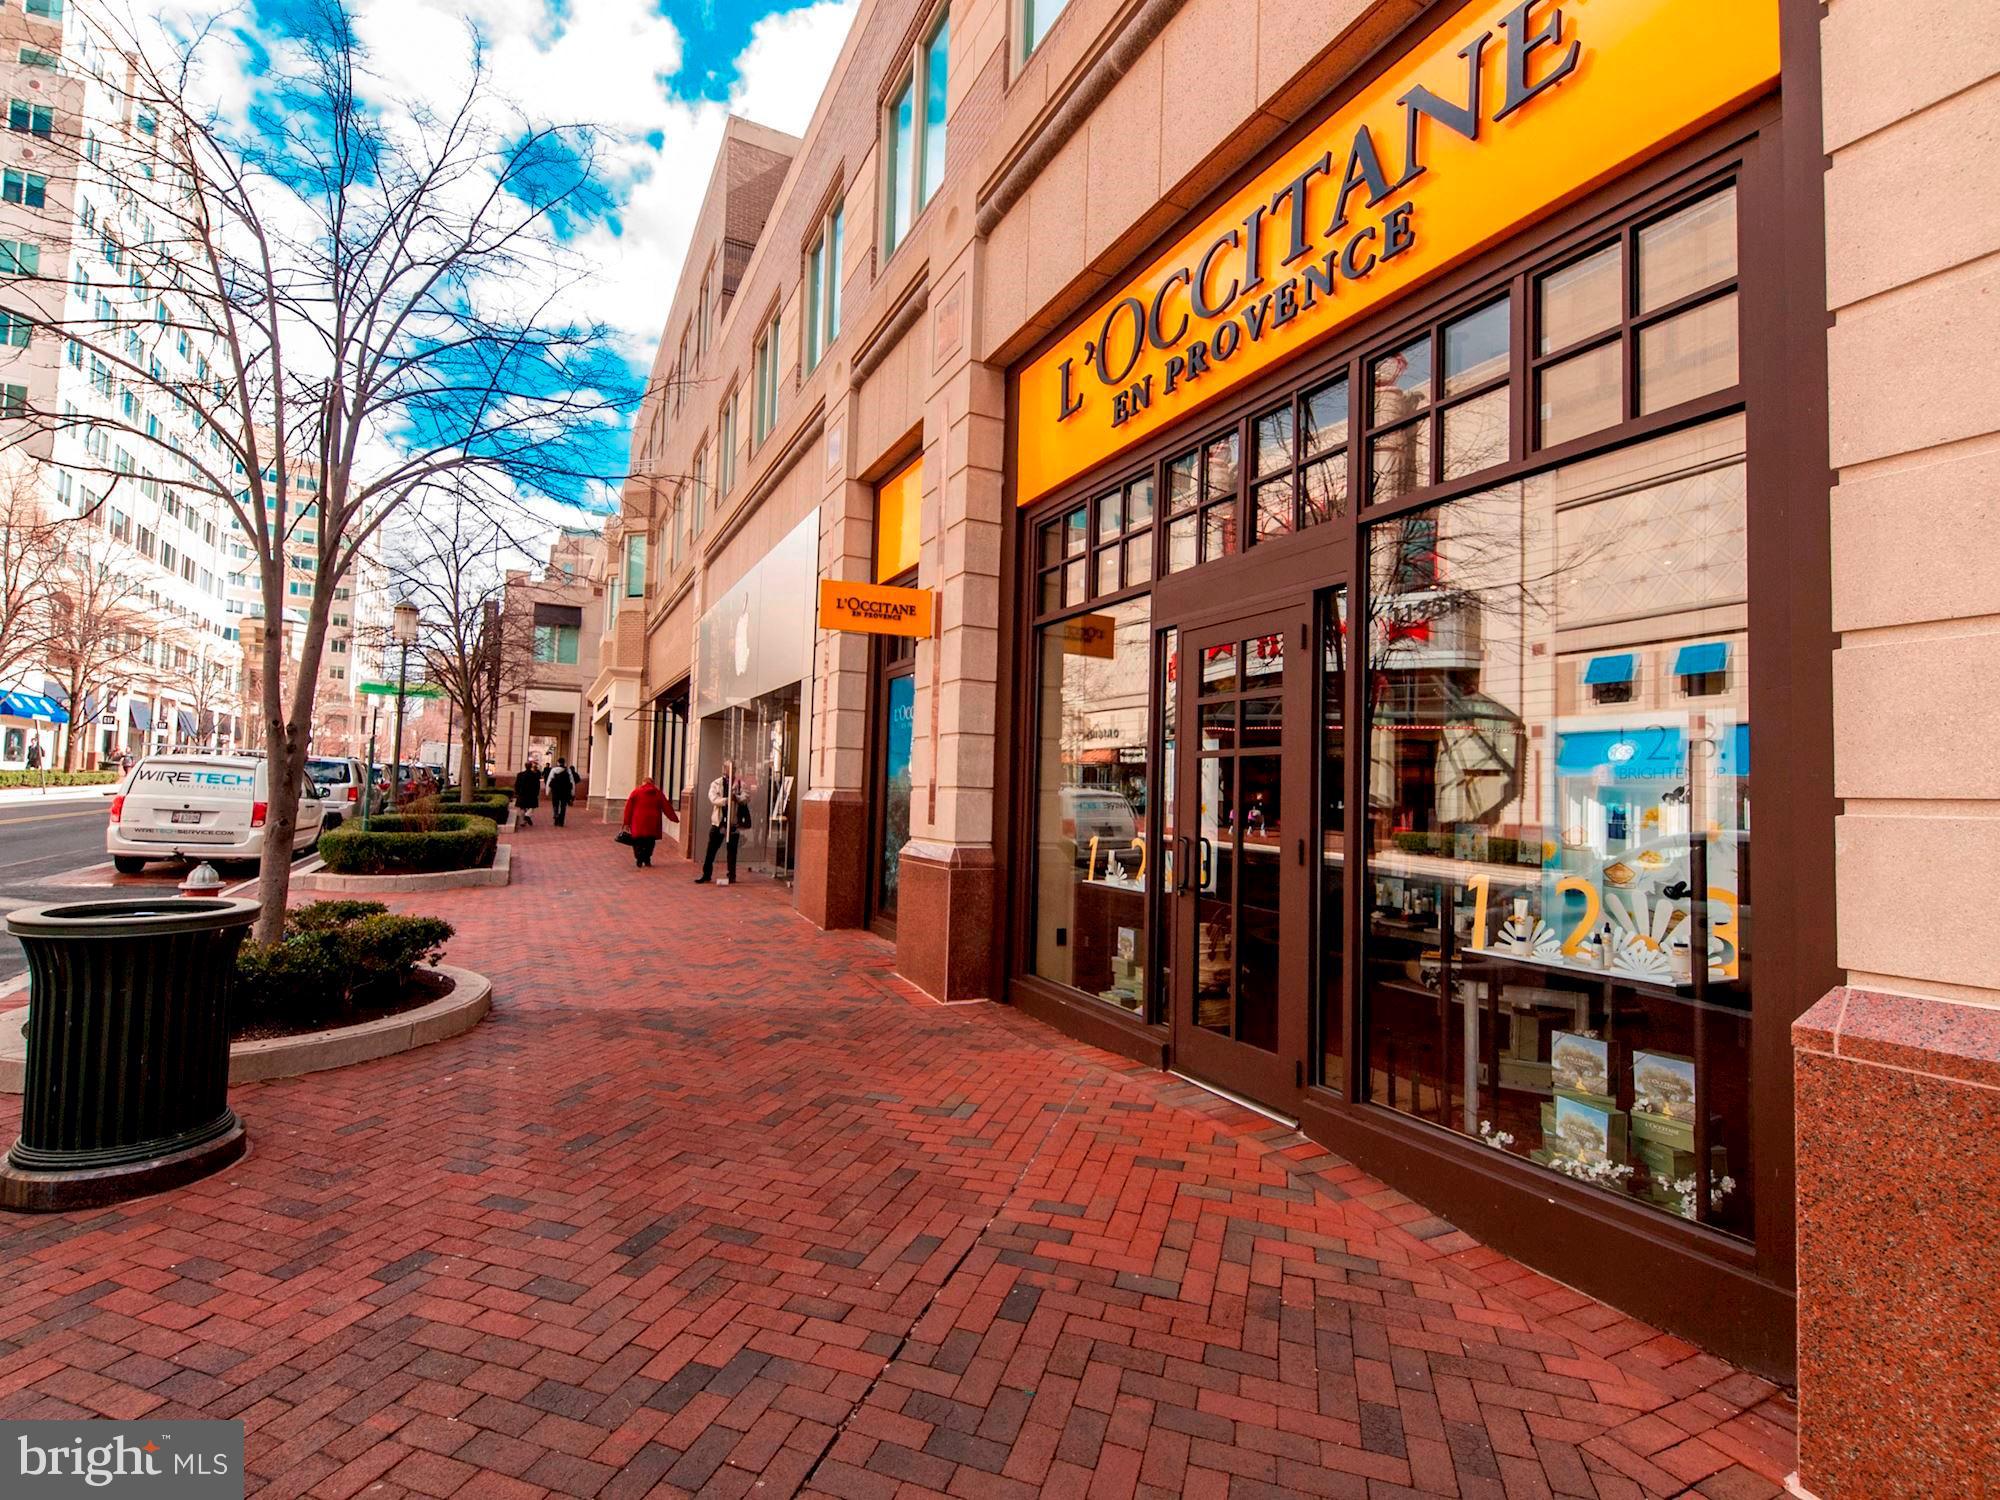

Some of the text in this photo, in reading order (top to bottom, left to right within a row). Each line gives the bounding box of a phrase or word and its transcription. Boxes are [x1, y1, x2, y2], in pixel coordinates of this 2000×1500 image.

[1057, 0, 1581, 422] L'OCCITANE
[1112, 201, 1416, 428] EN PROVENCE
[836, 597, 917, 616] L'OCCITANE
[864, 612, 902, 621] PROVENCE
[1468, 874, 1490, 950] 1
[1555, 877, 1600, 957] 2
